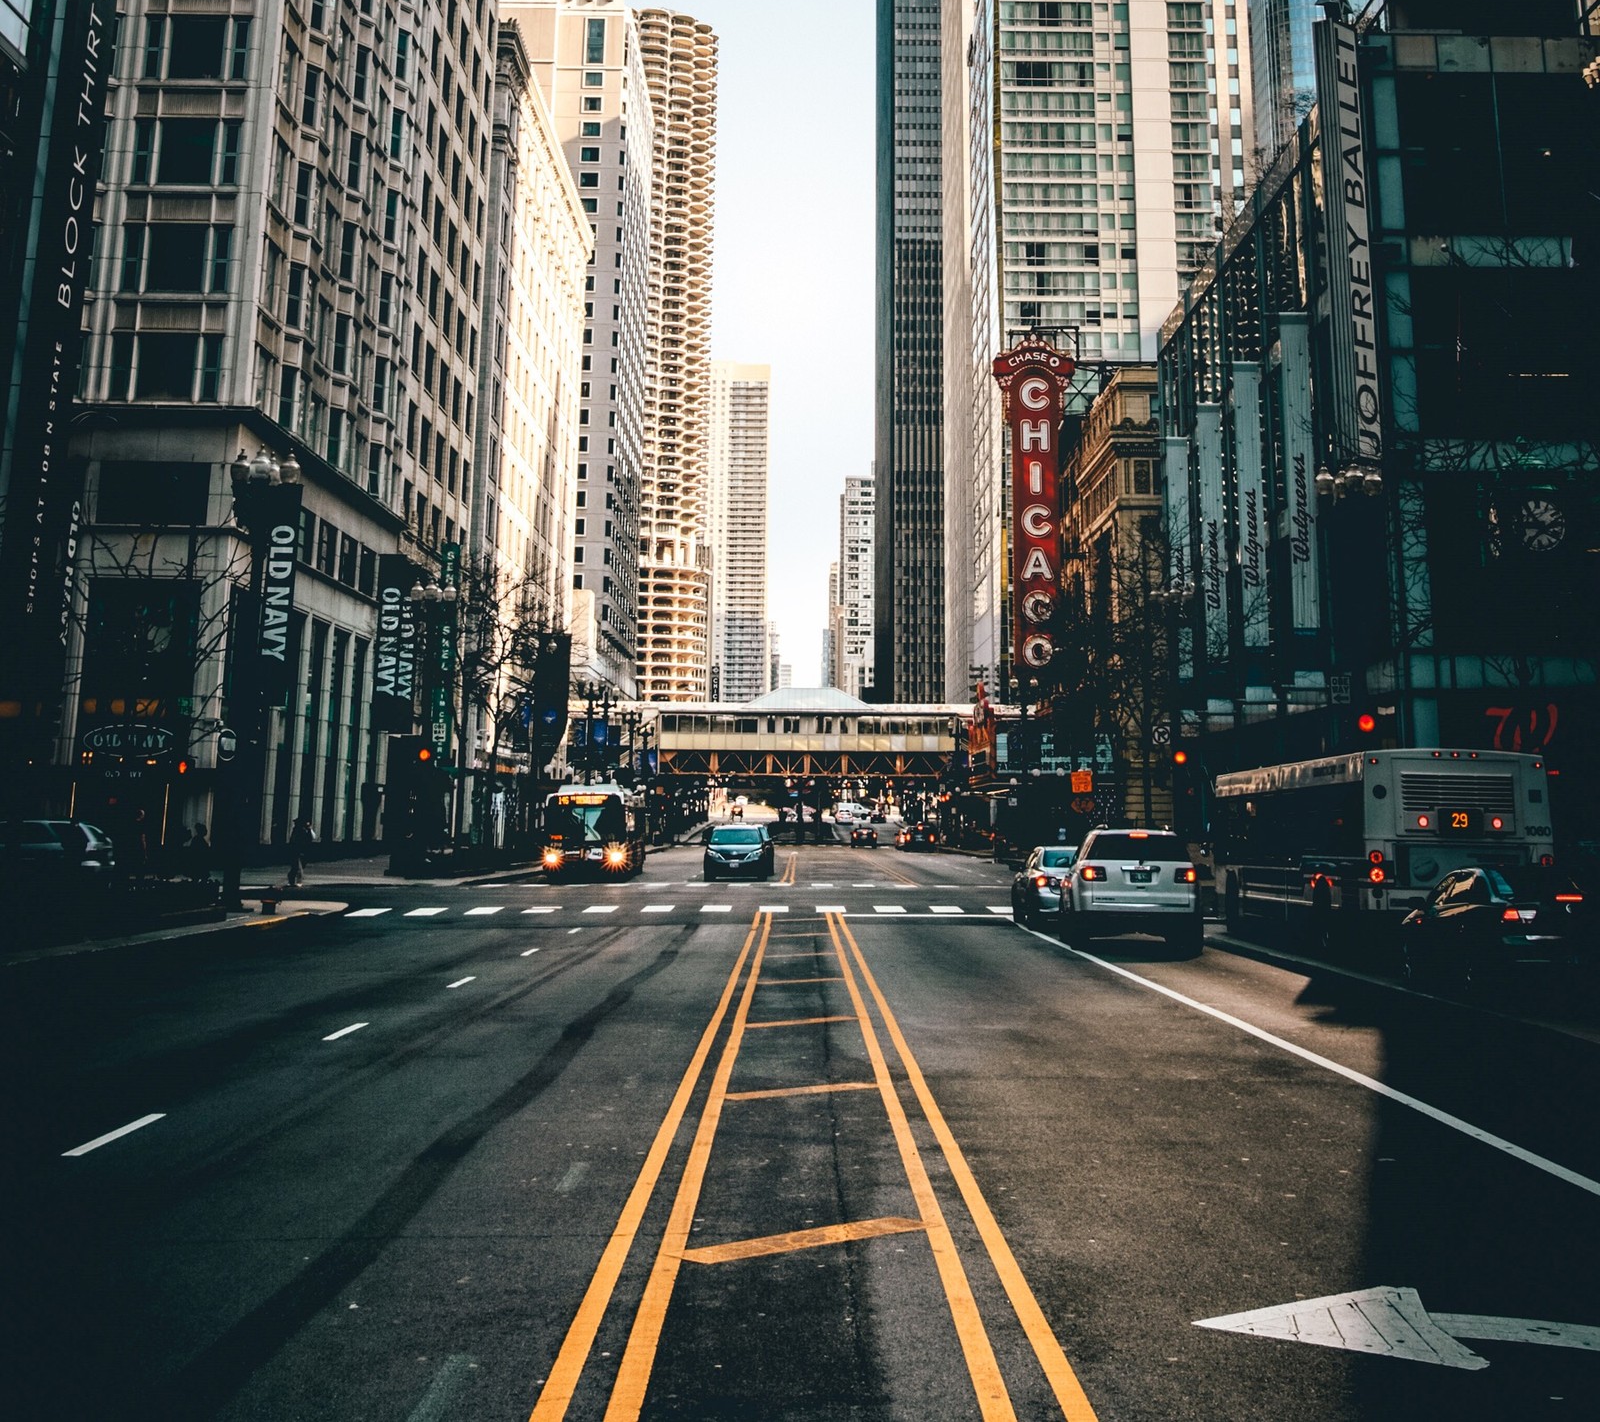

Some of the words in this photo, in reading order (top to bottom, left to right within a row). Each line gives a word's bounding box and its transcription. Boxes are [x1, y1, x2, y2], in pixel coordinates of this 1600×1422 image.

[1335, 27, 1365, 209] BALLET
[57, 145, 88, 310] BLOCK
[49, 342, 63, 411] STATE
[1008, 352, 1048, 367] CHASE
[1348, 234, 1382, 457] JOFFREY
[46, 420, 54, 435] N
[41, 444, 51, 484] 108
[36, 498, 45, 524] AT
[67, 500, 81, 559] OLD
[1019, 377, 1055, 669] CHICAGO
[1243, 489, 1265, 590] Walgreens
[1292, 453, 1315, 564] Walgreens
[26, 536, 42, 614] SHOPS
[268, 525, 296, 580] OLD
[1207, 519, 1225, 611] Walgreens
[261, 586, 290, 662] NAVY
[381, 587, 401, 631] OLD
[376, 636, 397, 696] NAVY
[1332, 686, 1349, 694] WAY
[1451, 812, 1469, 829] 29
